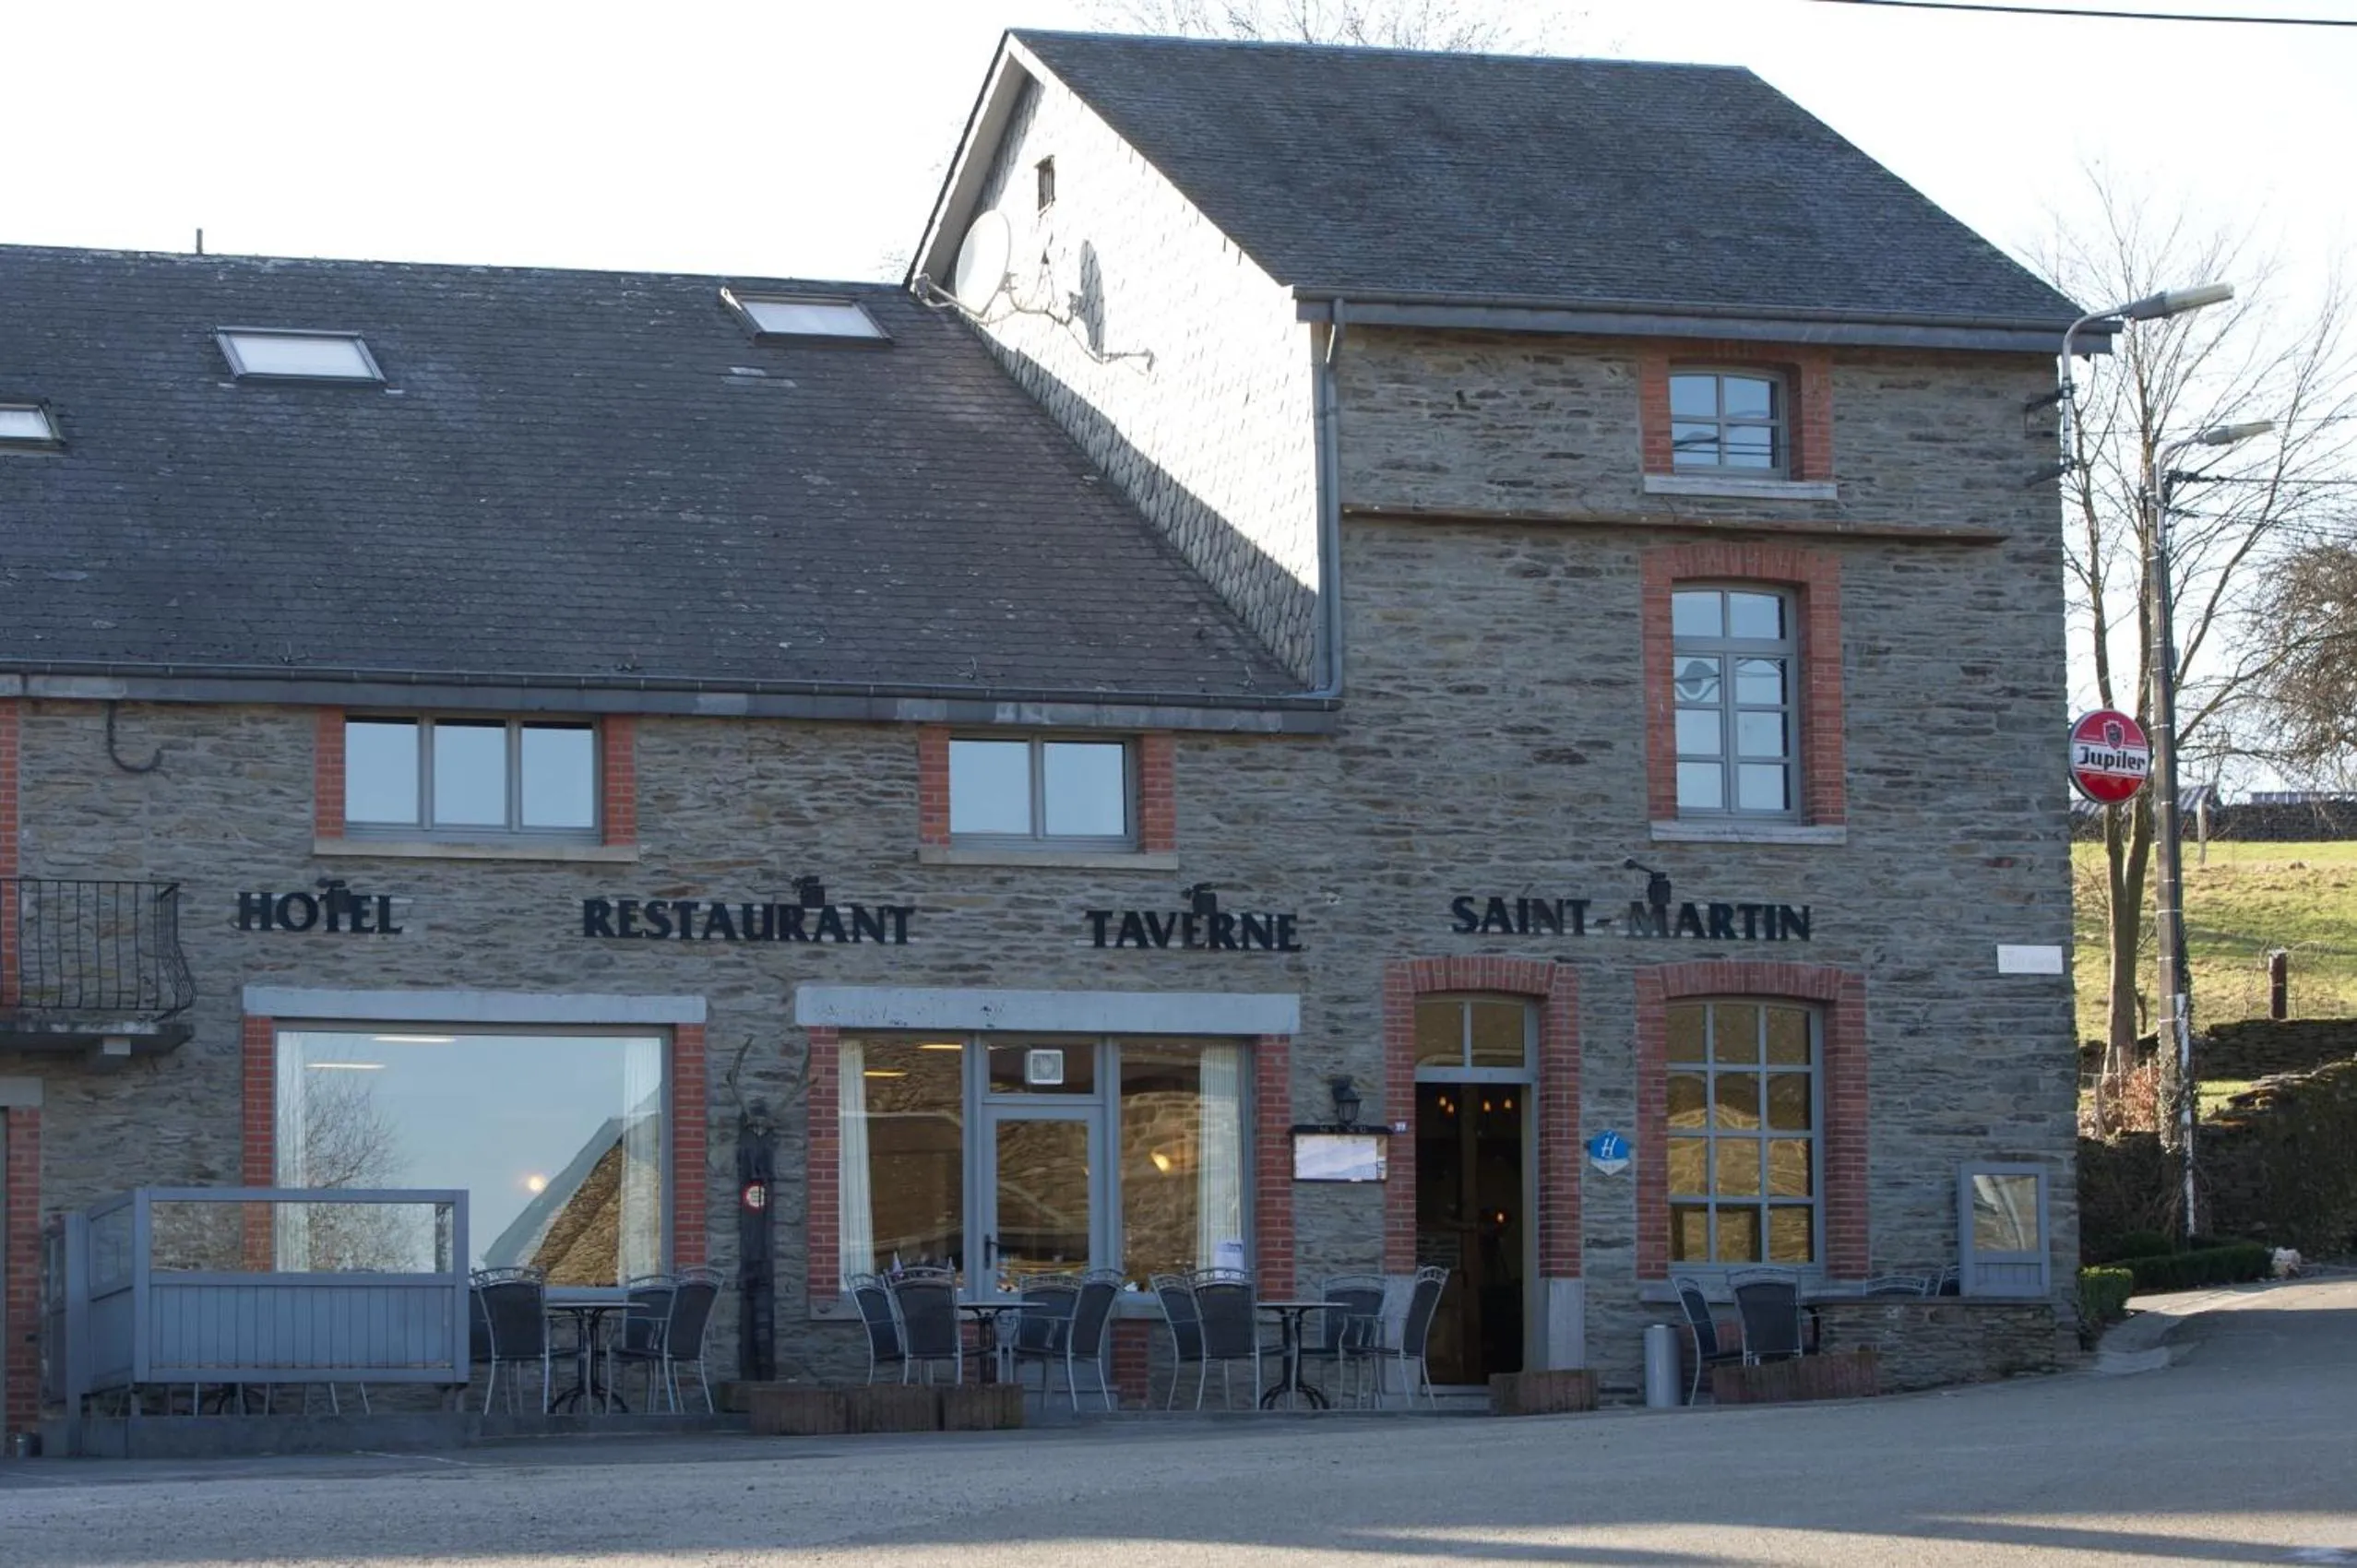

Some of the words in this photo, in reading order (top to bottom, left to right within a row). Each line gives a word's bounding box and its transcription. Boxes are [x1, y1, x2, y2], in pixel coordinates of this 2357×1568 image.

[2077, 746, 2145, 771] Jupiler
[238, 892, 403, 933] HOTEL
[583, 898, 914, 944] RESTAURANT
[1086, 909, 1303, 953] TAVERNE
